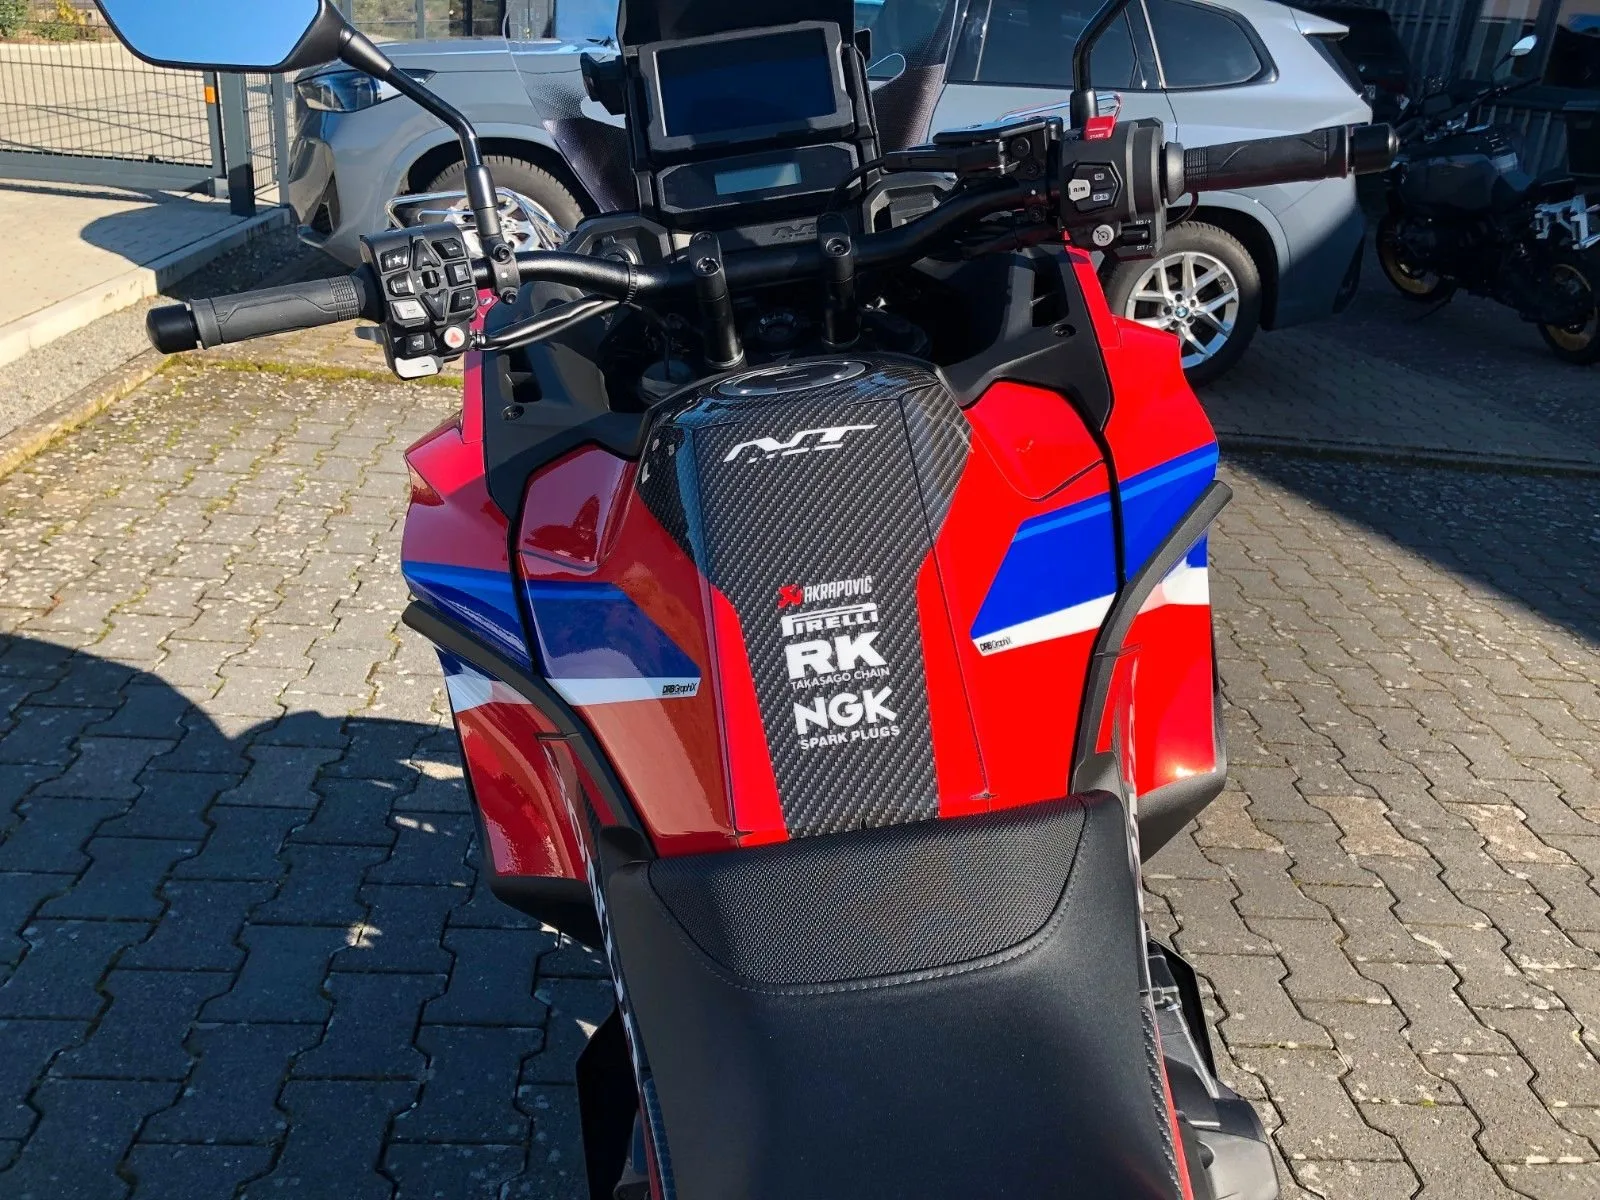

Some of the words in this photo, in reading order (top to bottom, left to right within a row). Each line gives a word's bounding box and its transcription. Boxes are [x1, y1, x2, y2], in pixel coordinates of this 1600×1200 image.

[780, 602, 879, 637] PIRELLI
[784, 631, 888, 680] RK
[790, 672, 851, 691] TAKASAGO
[853, 667, 891, 681] CHAIN
[793, 686, 898, 735] NGK
[800, 731, 848, 750] SPARK
[850, 725, 901, 742] PLUGS
